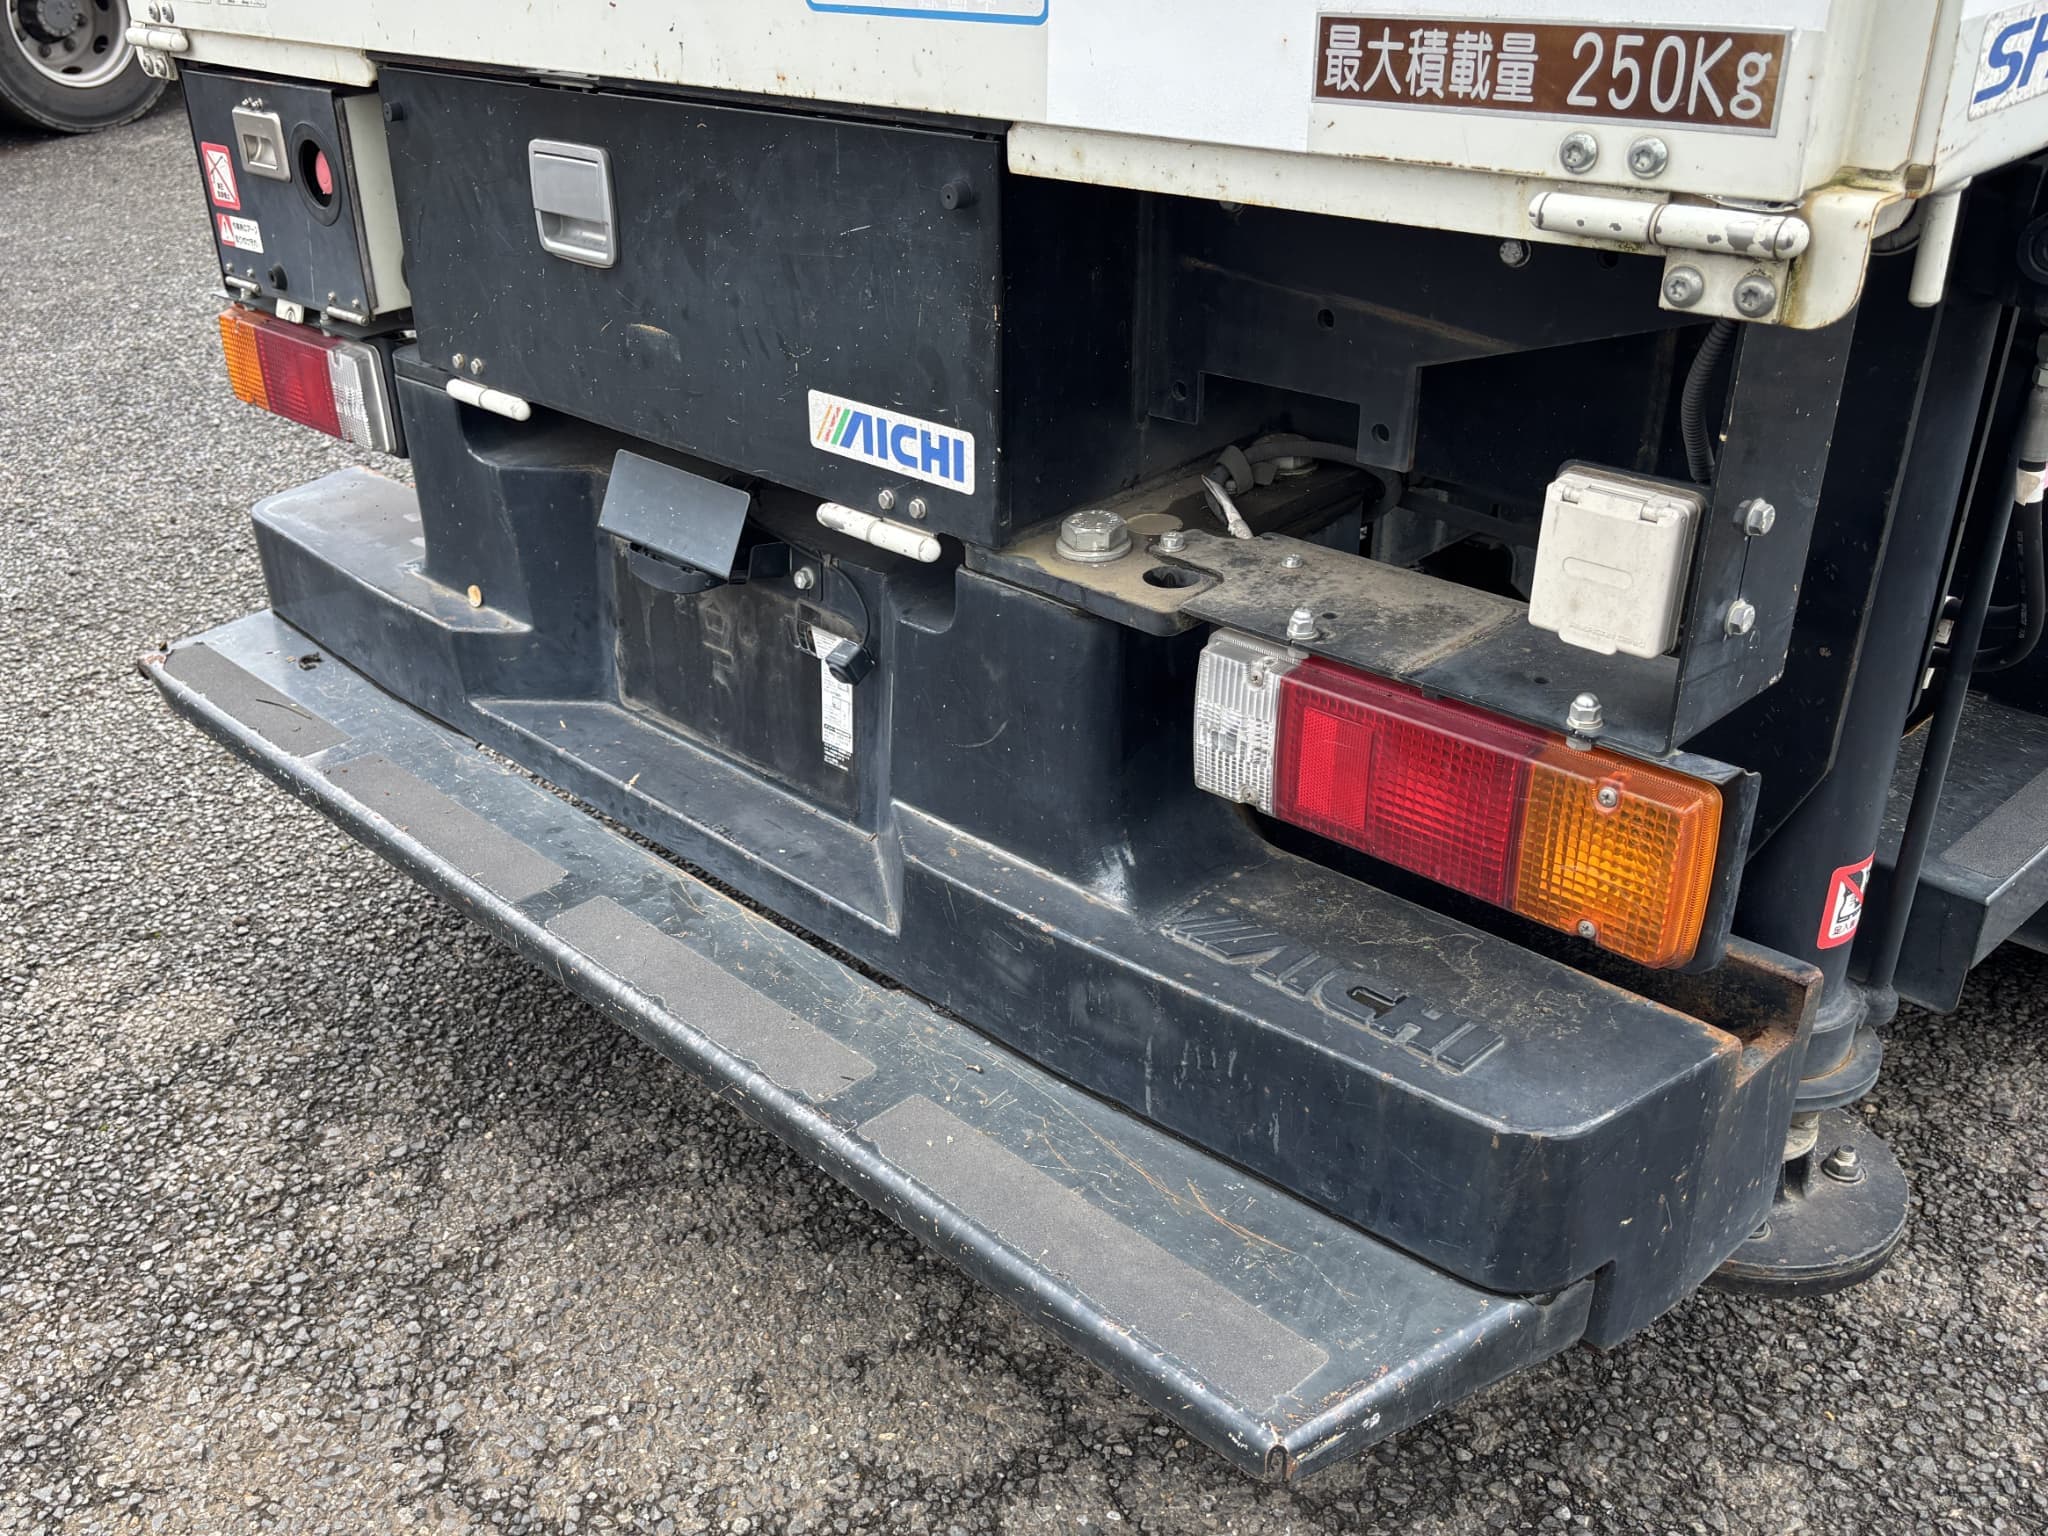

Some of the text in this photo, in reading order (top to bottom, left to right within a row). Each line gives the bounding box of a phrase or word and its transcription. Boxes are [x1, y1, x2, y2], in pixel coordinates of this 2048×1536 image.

[1323, 25, 1772, 119] 最大積載量 250Kg
[839, 410, 965, 484] AICHI
[1170, 918, 1504, 1076] AICHI
